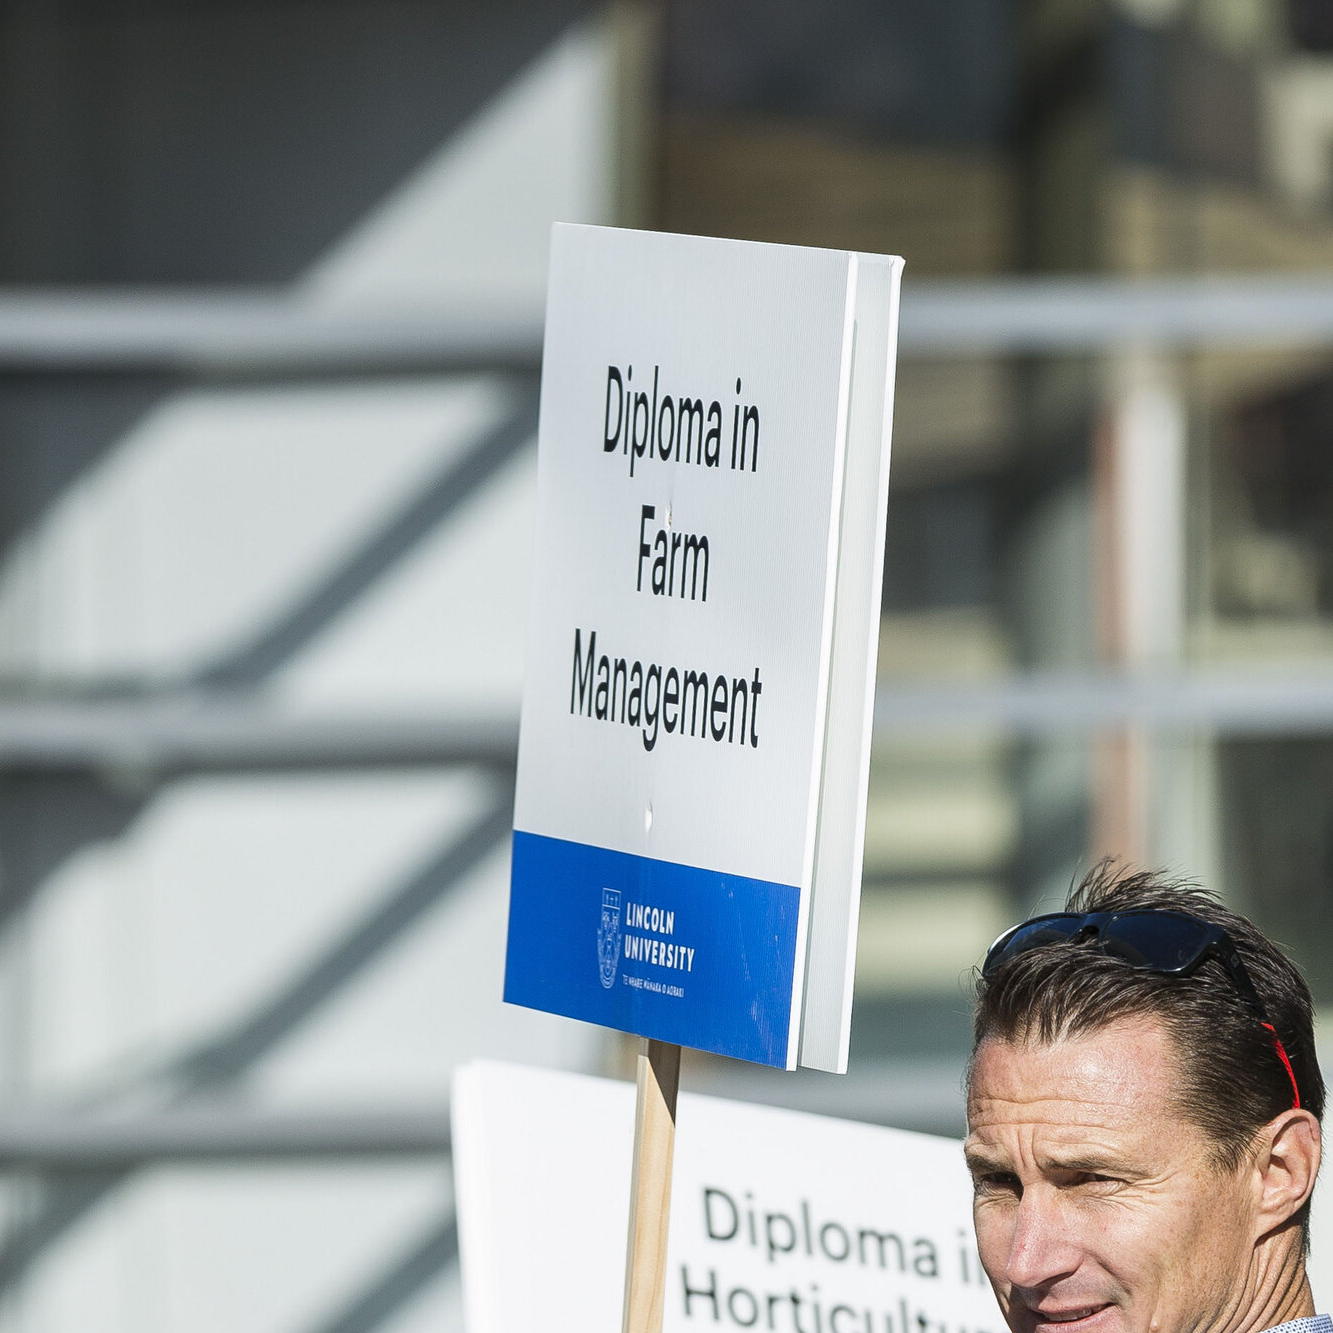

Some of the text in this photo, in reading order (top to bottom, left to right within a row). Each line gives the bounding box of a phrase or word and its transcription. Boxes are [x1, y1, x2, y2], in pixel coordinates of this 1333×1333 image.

[603, 365, 760, 478] Diploma in
[636, 504, 710, 602] Farm
[570, 628, 762, 752] Management
[624, 934, 695, 972] UNIVERSITY
[625, 902, 675, 935] LINCOLN
[702, 1186, 939, 1280] Diploma
